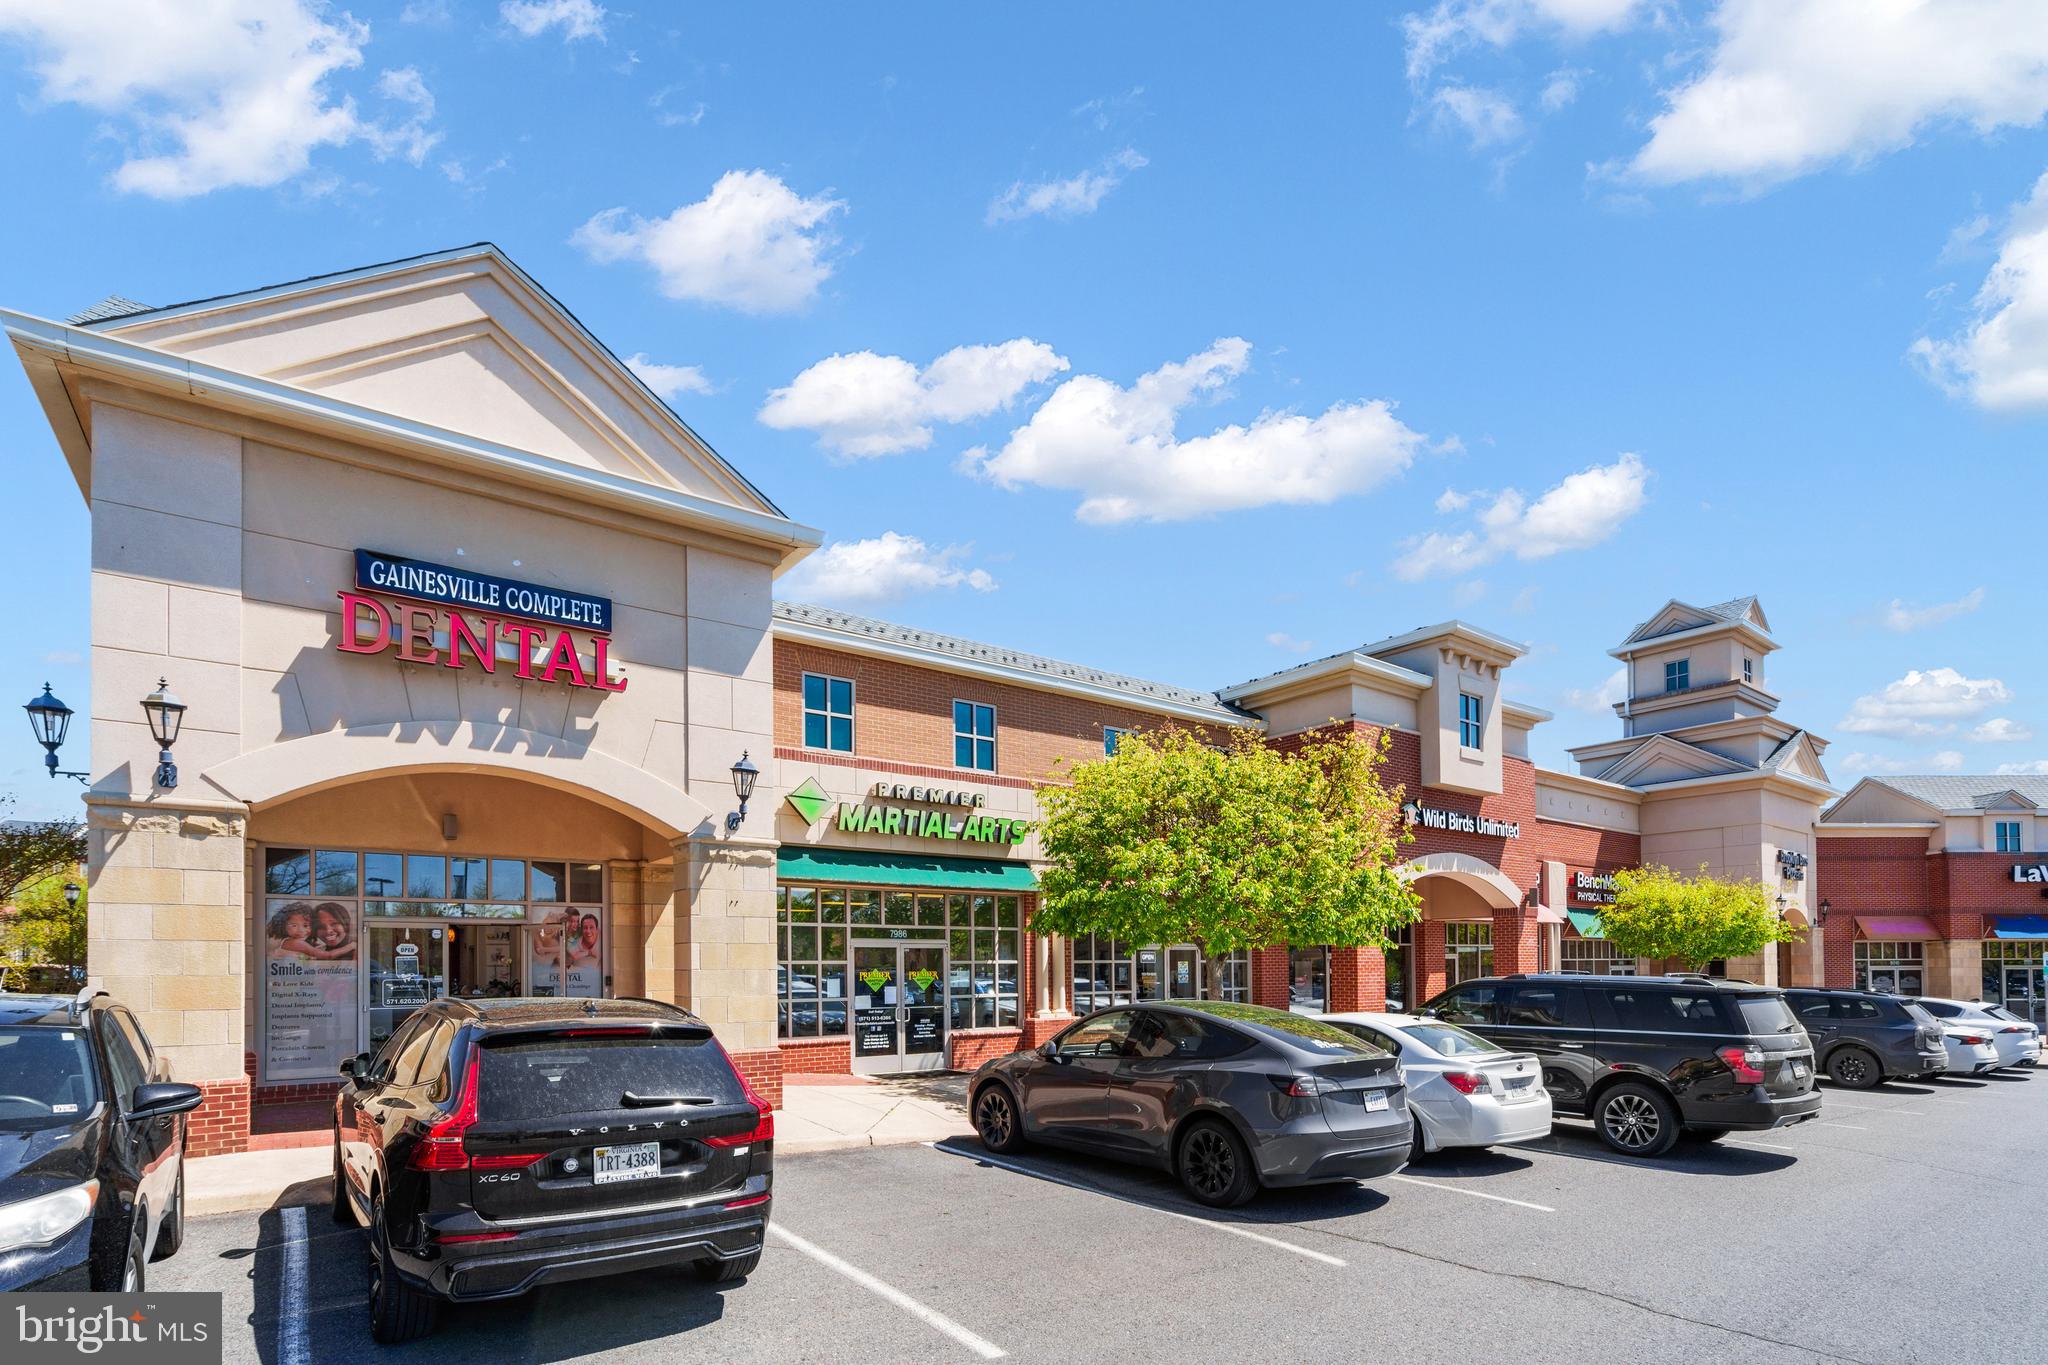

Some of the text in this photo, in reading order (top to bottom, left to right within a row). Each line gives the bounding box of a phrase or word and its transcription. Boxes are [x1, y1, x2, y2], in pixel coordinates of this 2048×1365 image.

[369, 560, 603, 626] GAINESVILLE COMPLETE
[335, 590, 629, 692] DENTAL
[876, 782, 986, 808] PREMIER
[836, 803, 1028, 846] MARTIAL ARTS
[1423, 808, 1520, 840] Wild Birds Unlimited
[1577, 891, 1602, 903] PHYSICAL
[270, 962, 303, 976] Smile
[317, 965, 353, 977] confidence
[549, 973, 583, 982] DETAL
[568, 1119, 689, 1136] VOLVO
[611, 1146, 643, 1155] VIRGINIA
[598, 1151, 656, 1171] TRT-4388
